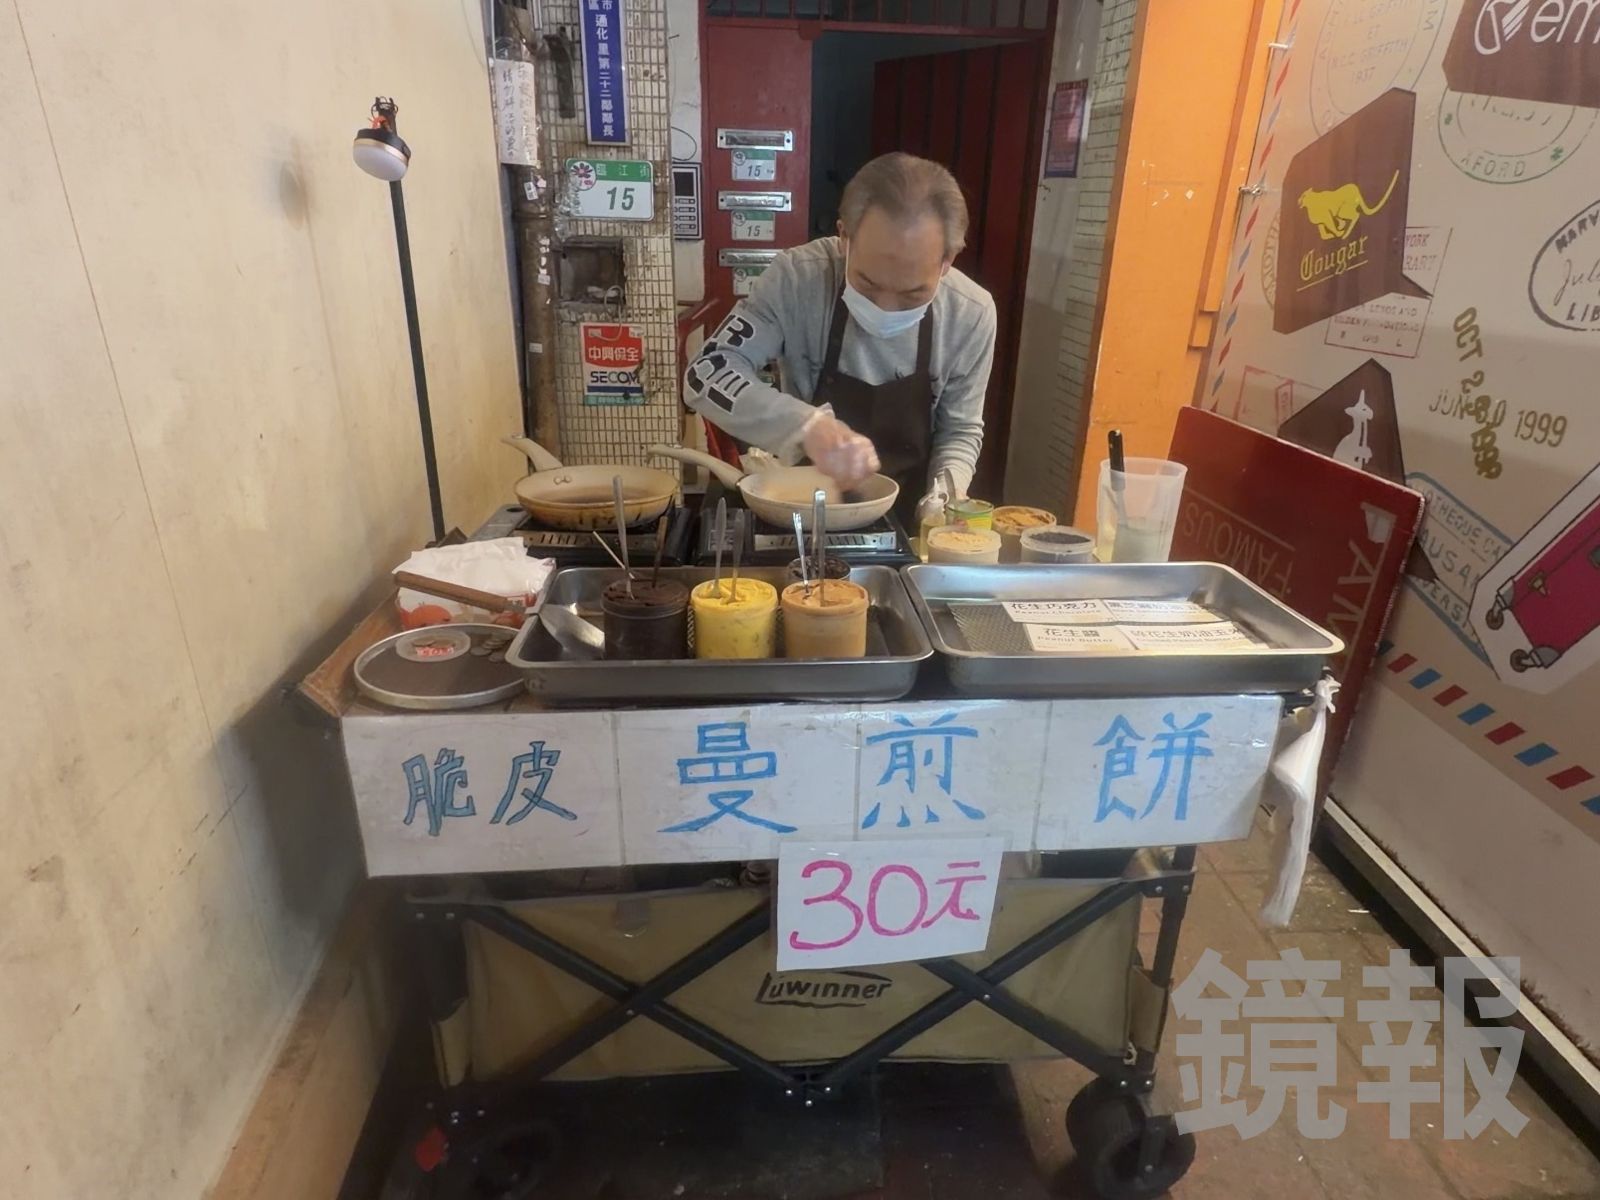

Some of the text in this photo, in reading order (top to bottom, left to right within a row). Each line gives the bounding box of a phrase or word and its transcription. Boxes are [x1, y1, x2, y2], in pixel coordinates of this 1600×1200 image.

[747, 164, 761, 178] 15
[606, 186, 635, 211] 15
[747, 225, 760, 237] 15
[1299, 235, 1368, 282] Cougar
[1453, 306, 1483, 362] OCT
[1514, 410, 1567, 448] 1999
[789, 859, 988, 950] 30元
